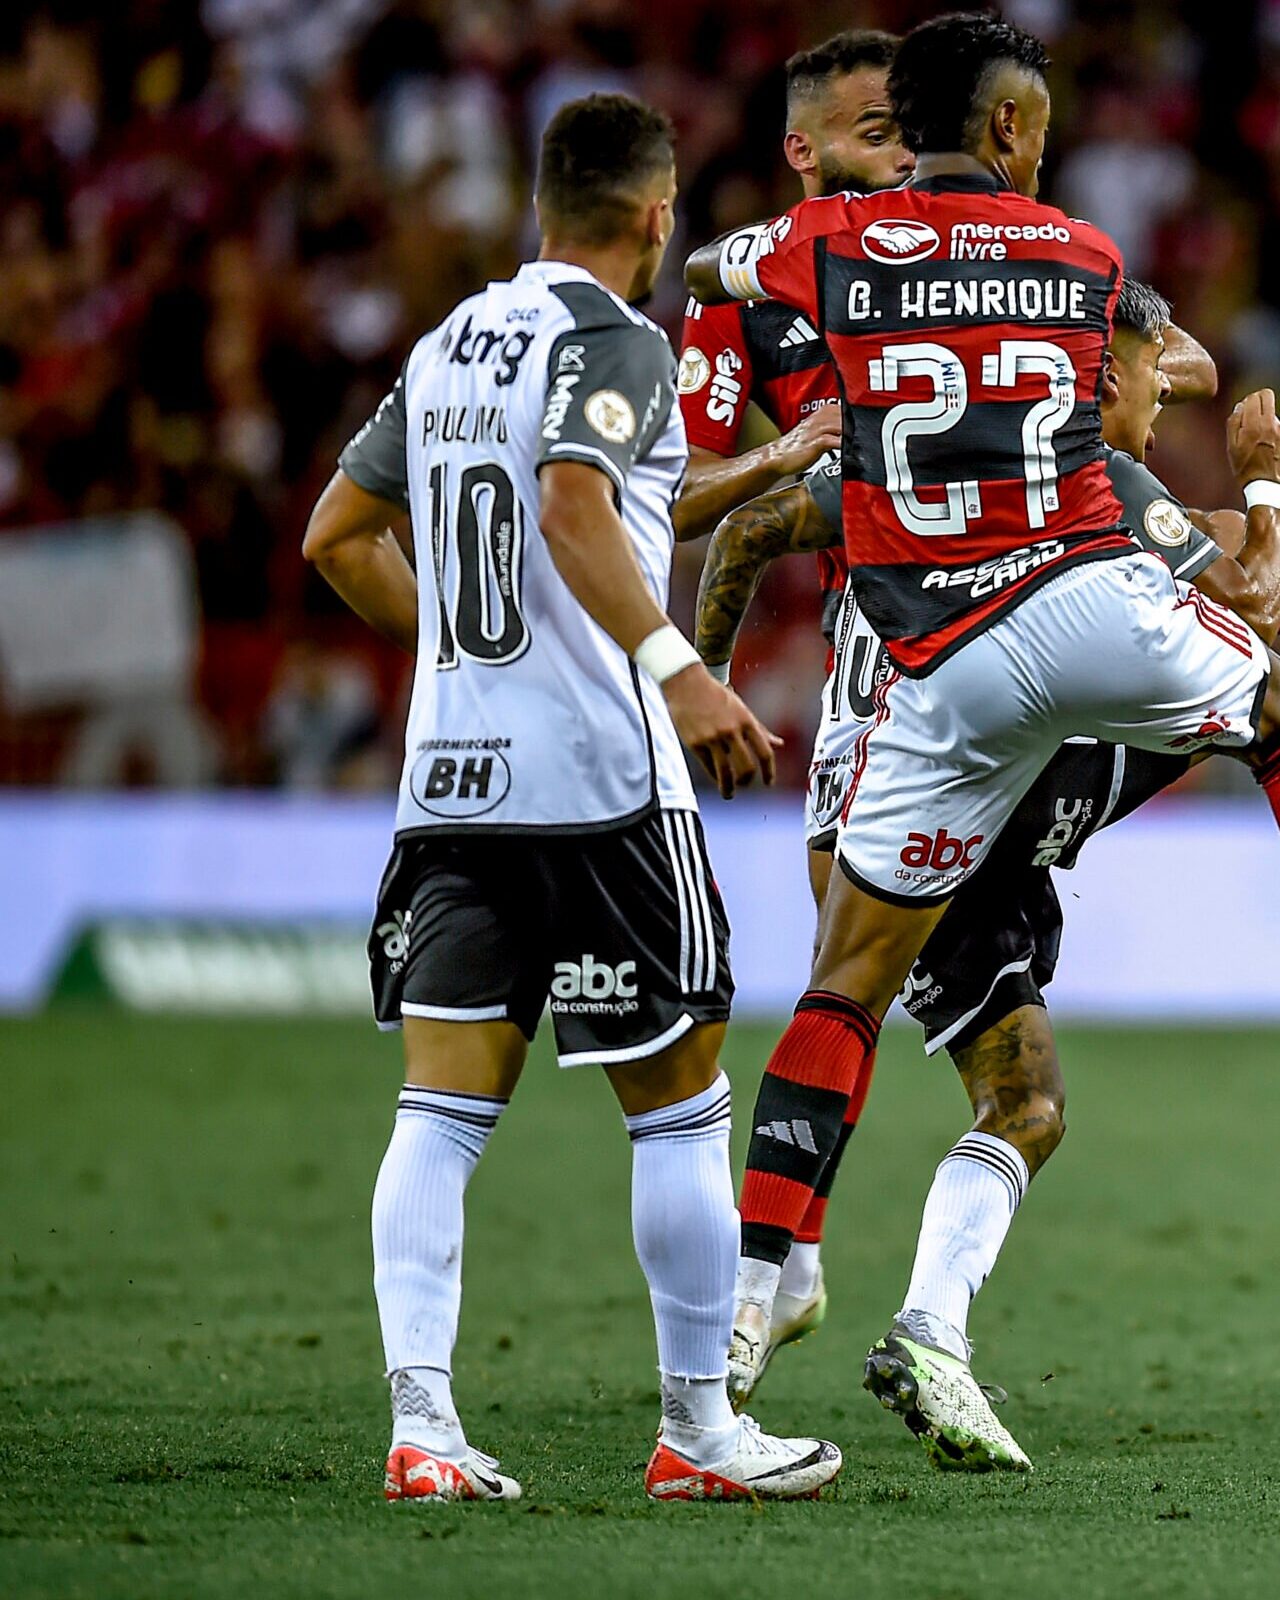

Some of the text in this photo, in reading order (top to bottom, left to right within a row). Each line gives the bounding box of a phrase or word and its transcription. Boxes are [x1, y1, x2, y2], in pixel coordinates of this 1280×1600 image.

[950, 239, 1007, 261] livre
[951, 222, 1071, 244] mercado
[848, 278, 1086, 320] B. HENRIQUE
[941, 362, 957, 391] TIM
[1055, 363, 1069, 389] TIM
[868, 340, 1077, 536] 27
[429, 462, 532, 671] 10
[424, 757, 493, 799] BH
[900, 829, 984, 870] abc
[1031, 798, 1082, 866] abc
[895, 869, 911, 880] da
[551, 954, 638, 1000] abc
[552, 1000, 639, 1017] da construção
